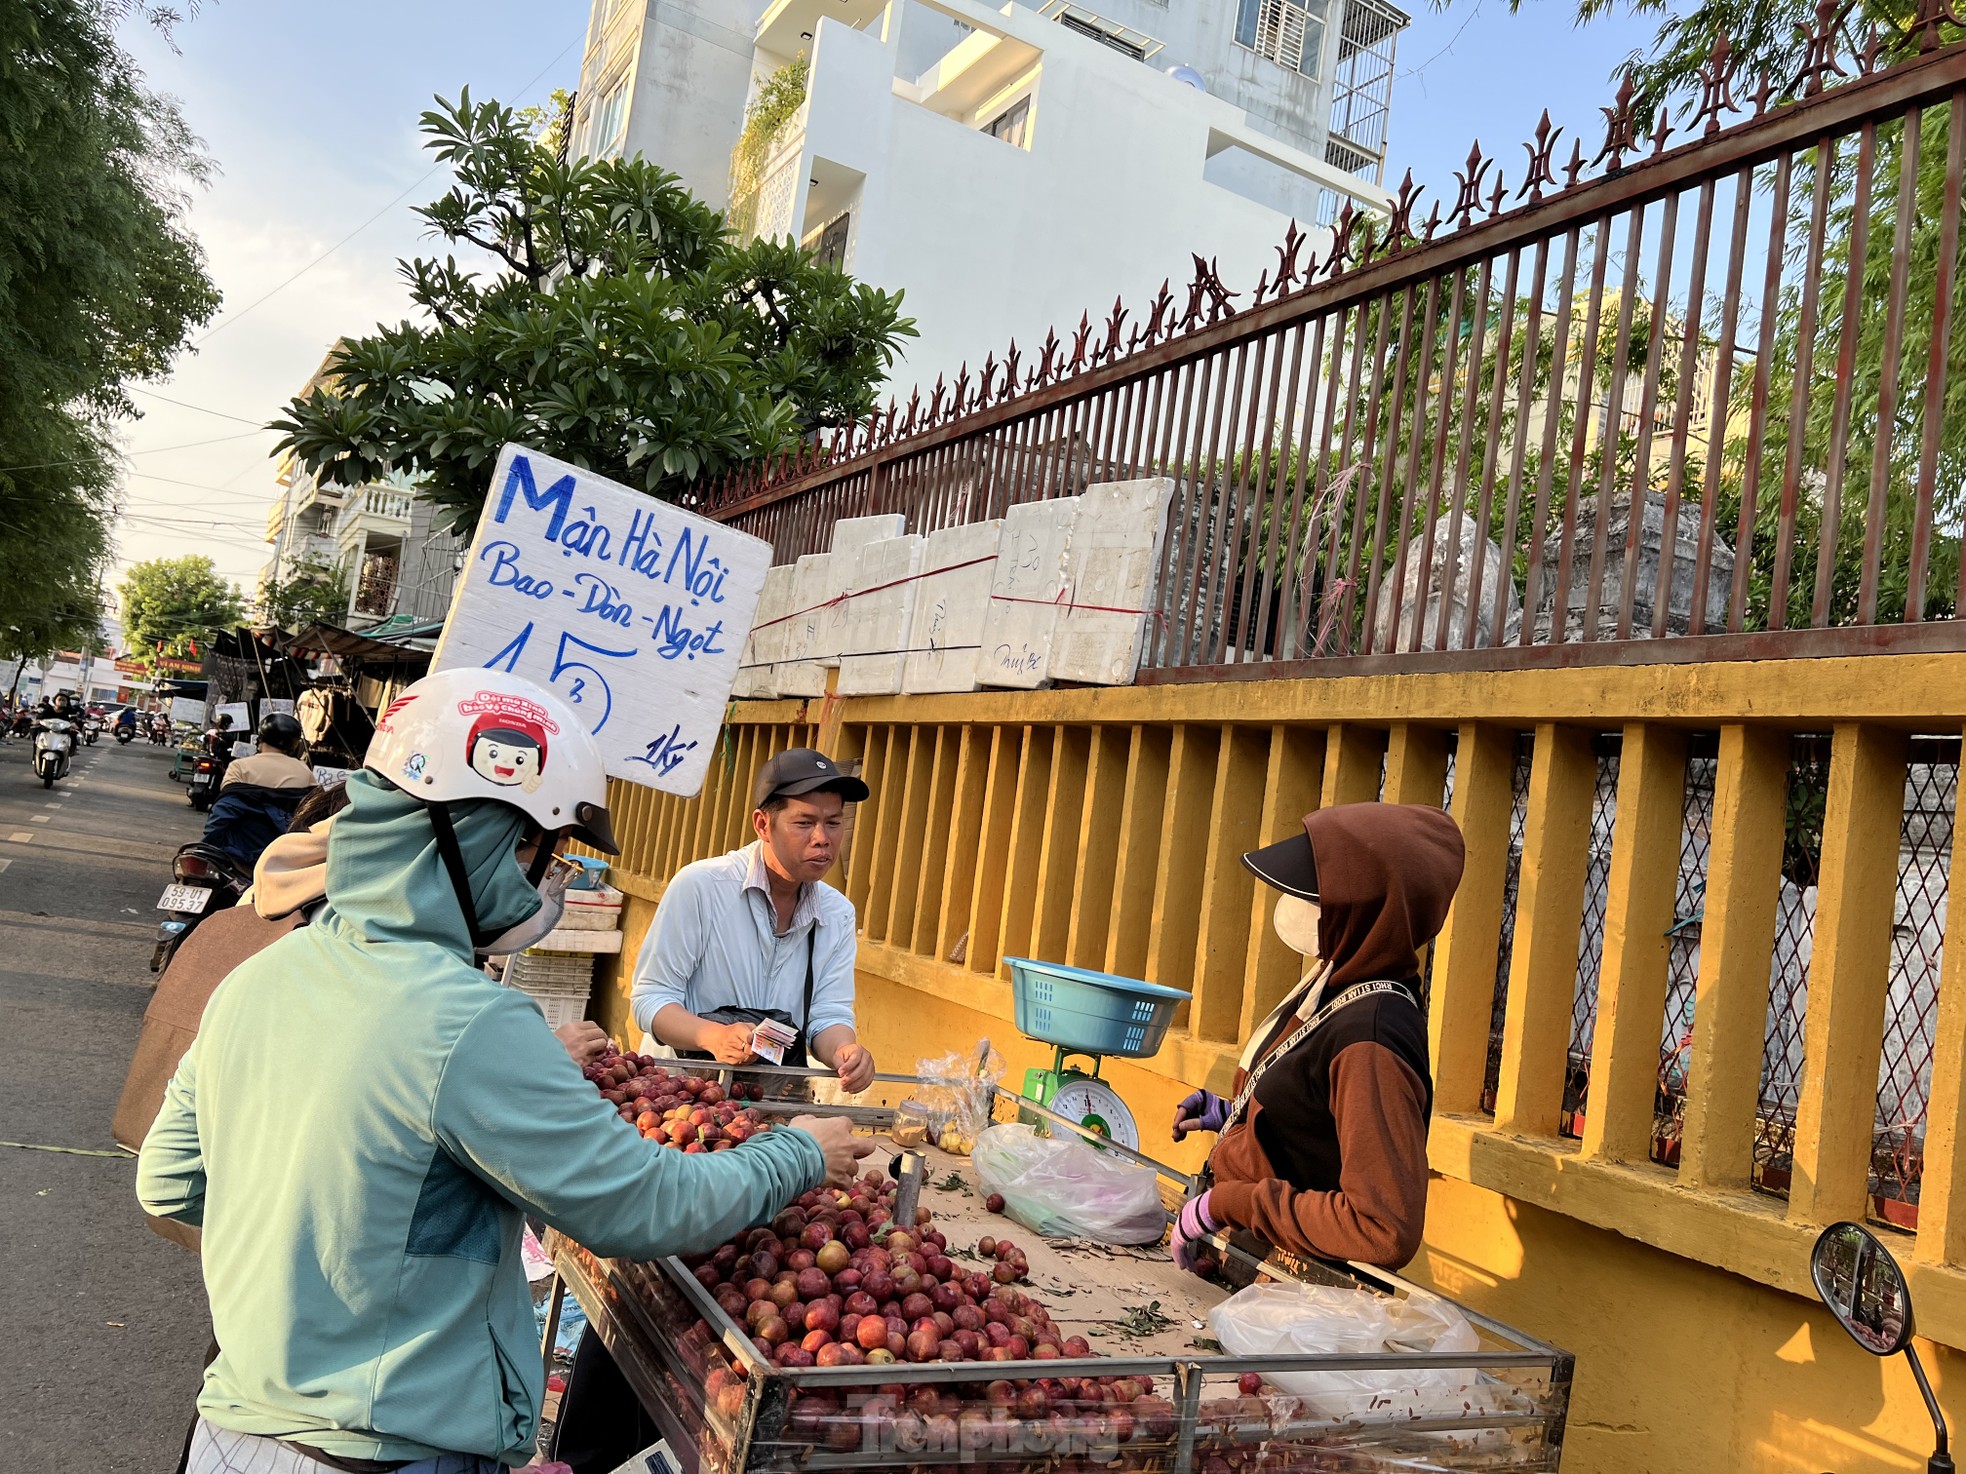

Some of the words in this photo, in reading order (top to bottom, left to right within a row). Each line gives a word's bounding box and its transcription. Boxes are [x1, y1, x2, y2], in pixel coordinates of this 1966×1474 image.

[494, 454, 611, 561] Mận
[619, 508, 661, 580] Hà
[663, 527, 730, 607] Nội
[480, 540, 553, 600] Bao
[651, 604, 725, 660] Ngọt
[498, 718, 527, 729] HONDA
[171, 886, 203, 900] 59-U1
[161, 897, 204, 912] 095.37
